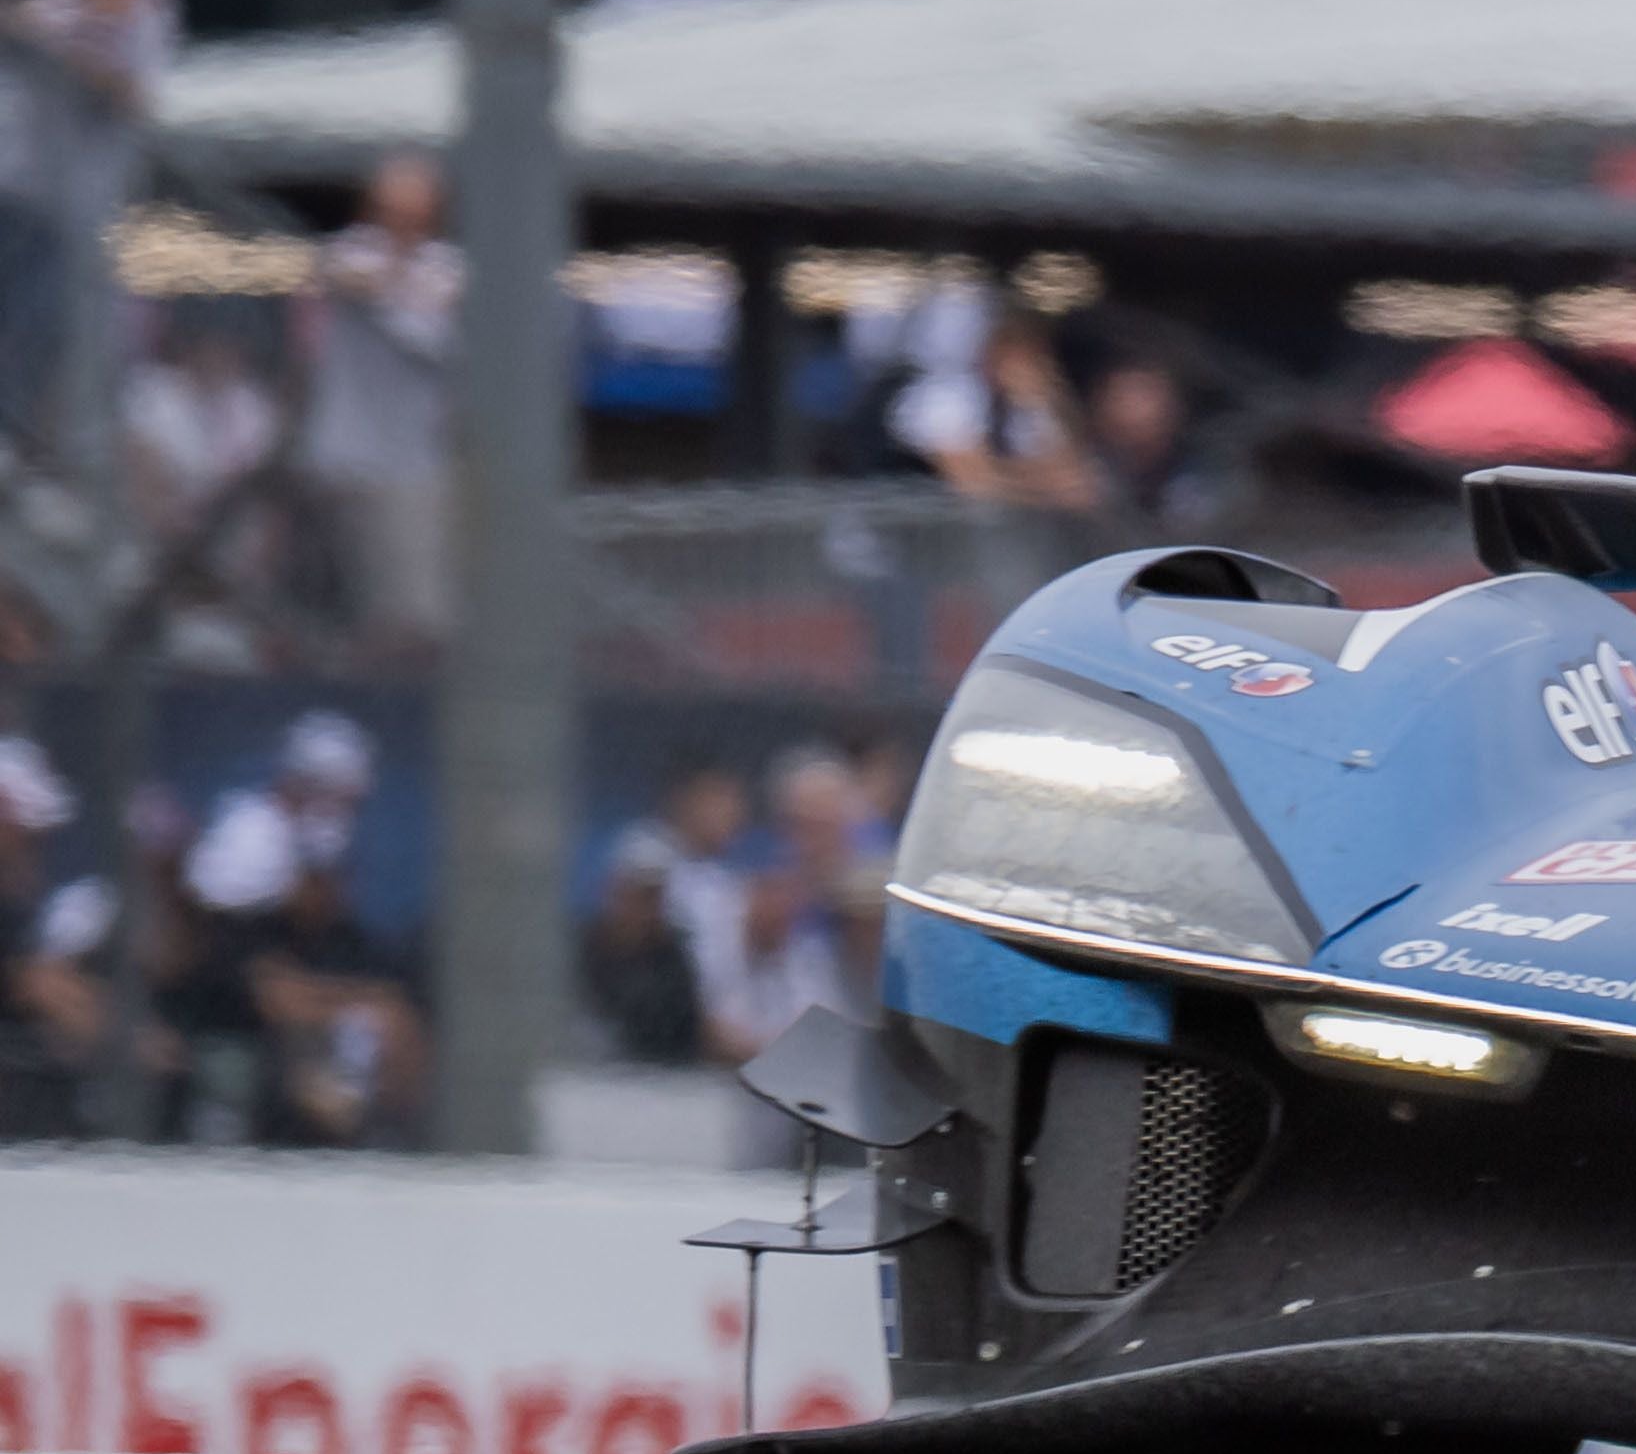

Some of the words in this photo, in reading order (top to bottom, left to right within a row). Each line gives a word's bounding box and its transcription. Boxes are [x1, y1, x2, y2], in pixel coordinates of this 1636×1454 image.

[1150, 634, 1270, 672] elf
[1542, 662, 1634, 764] elf
[1437, 902, 1610, 942] ixell
